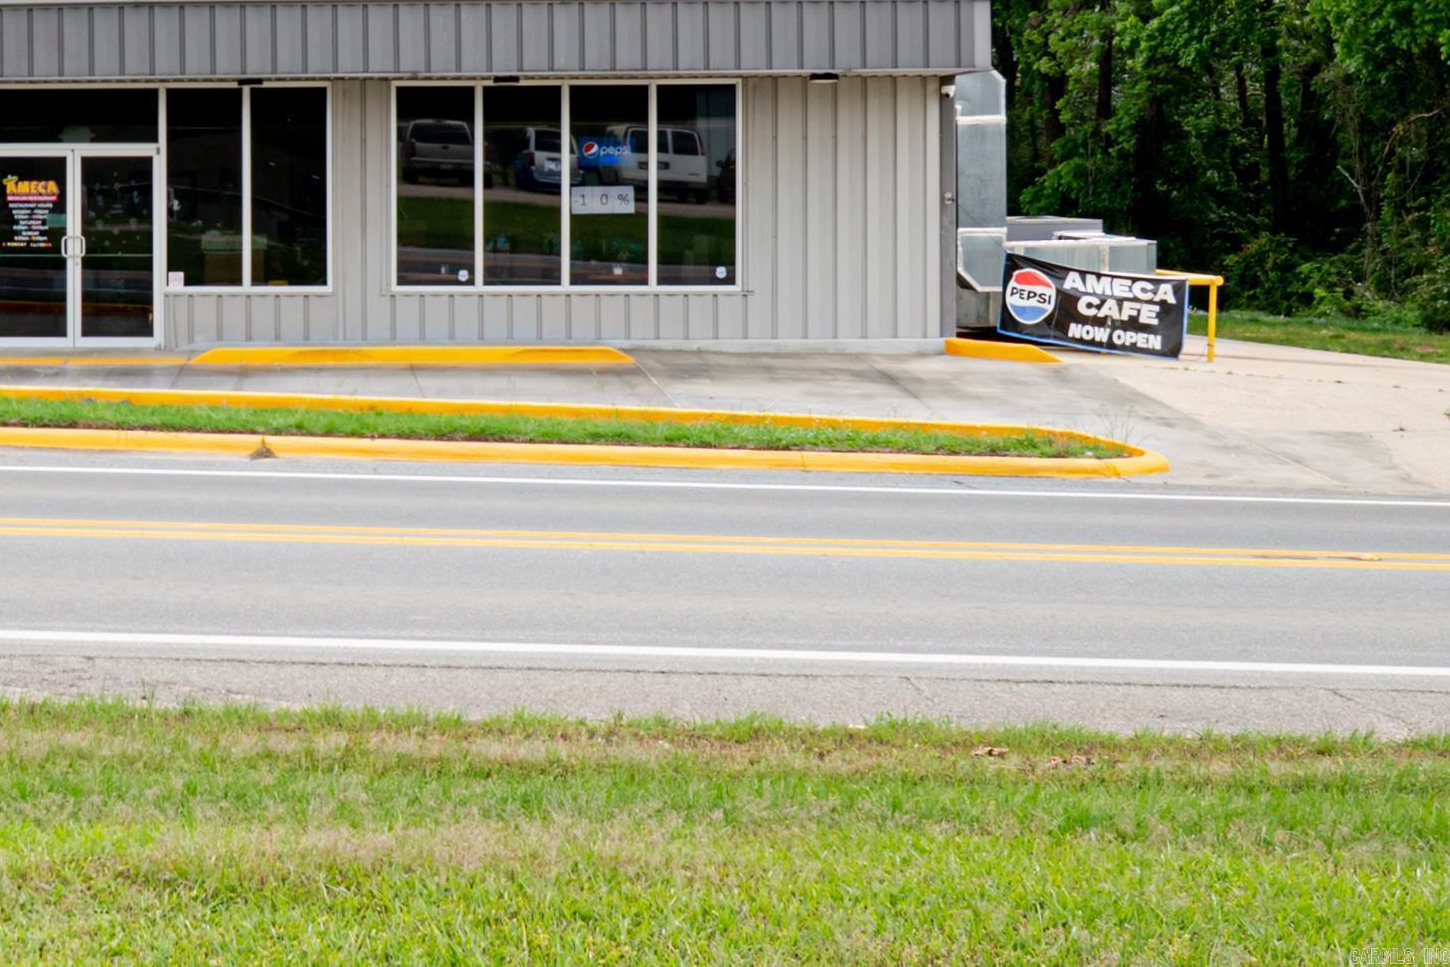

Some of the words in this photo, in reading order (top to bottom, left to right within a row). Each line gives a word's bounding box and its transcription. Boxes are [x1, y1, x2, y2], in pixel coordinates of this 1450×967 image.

[6, 180, 59, 195] AMECA
[1010, 286, 1052, 305] PEPSI
[1062, 271, 1177, 305] AMECA
[1077, 295, 1160, 326] CAFE
[1068, 322, 1110, 343] NOW
[1112, 331, 1162, 350] OPEN
